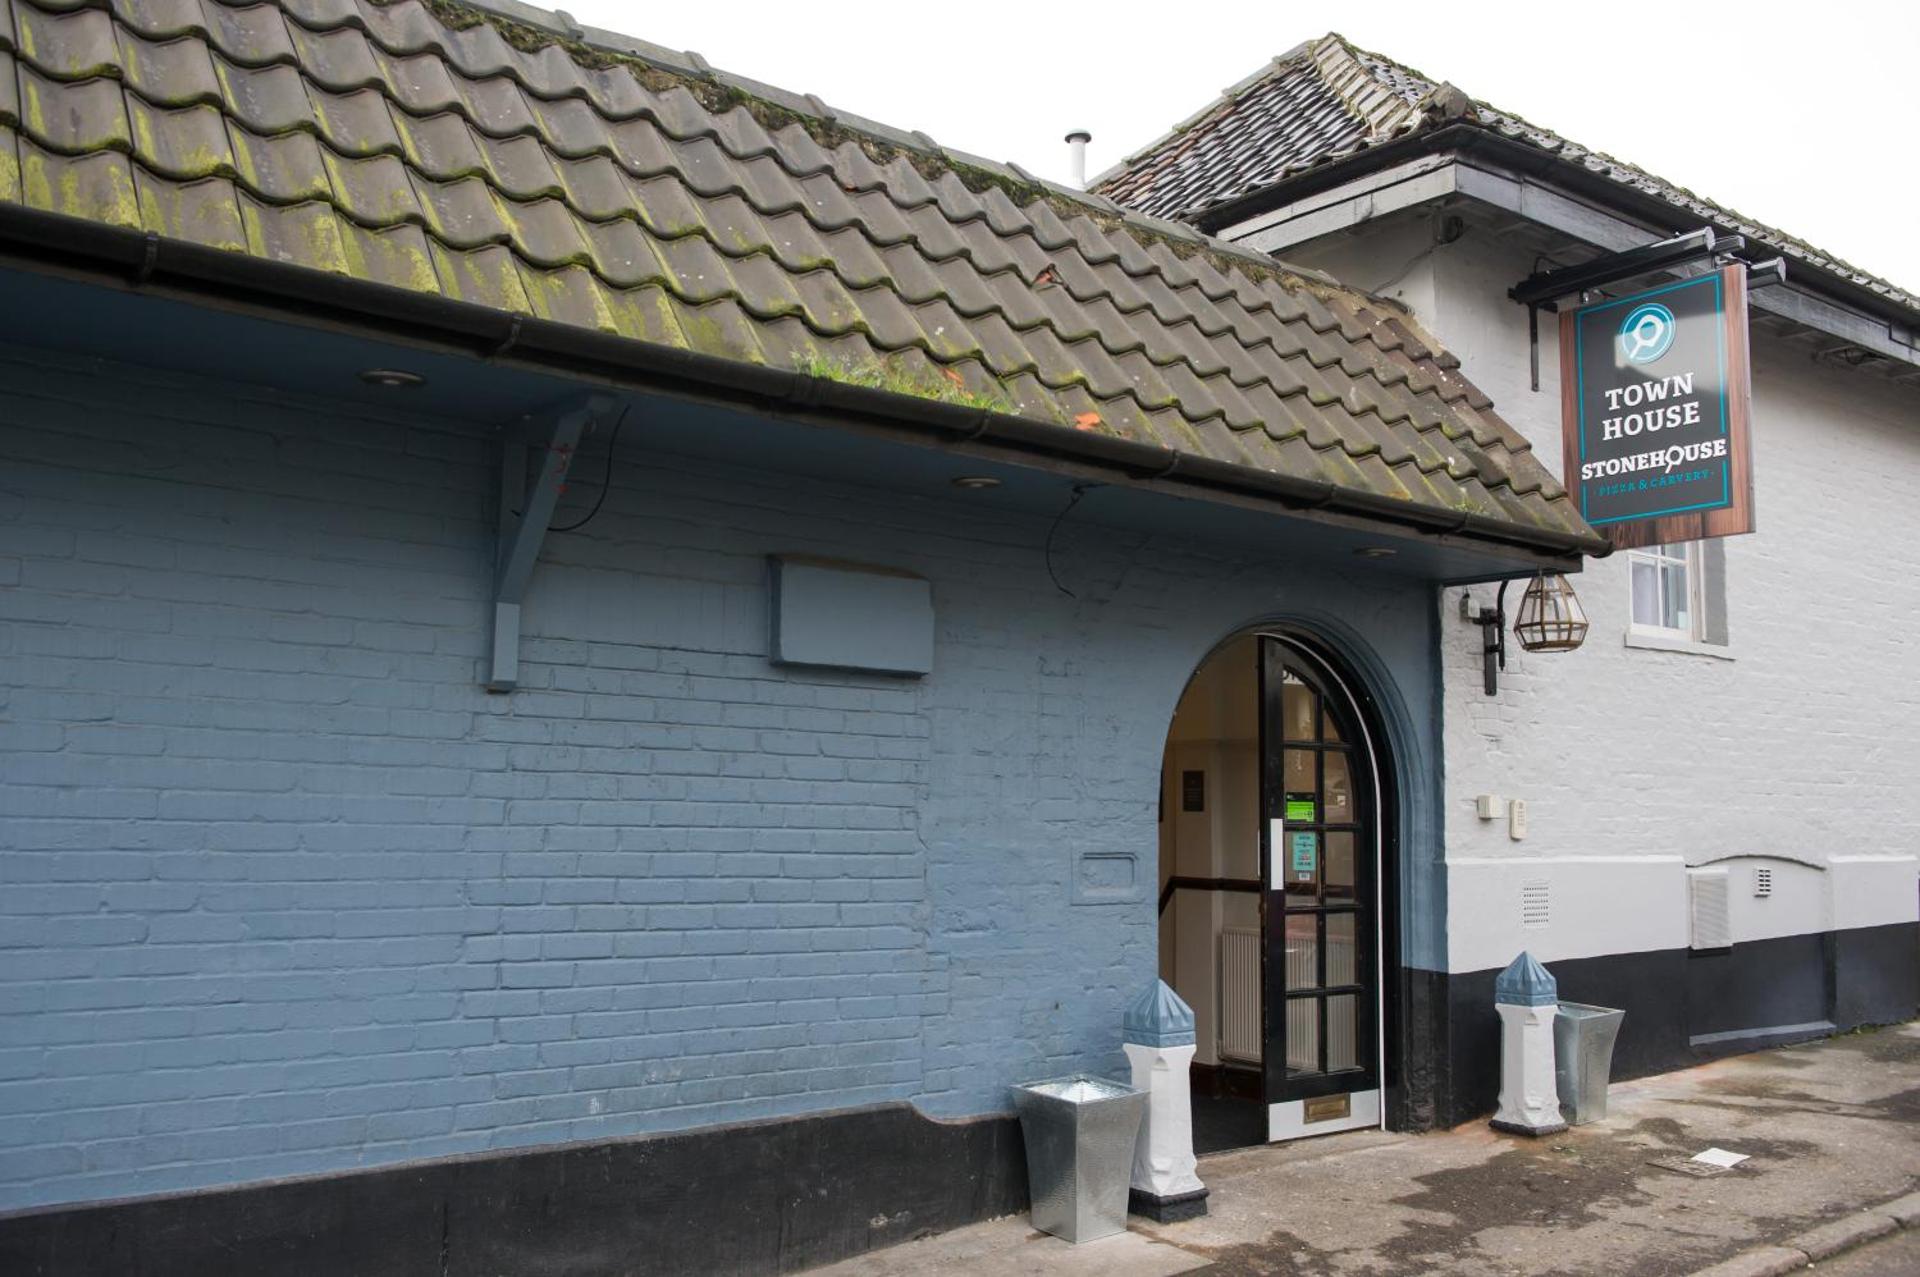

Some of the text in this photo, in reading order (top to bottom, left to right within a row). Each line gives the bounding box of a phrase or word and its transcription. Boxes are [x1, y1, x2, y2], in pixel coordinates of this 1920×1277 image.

[1605, 373, 1693, 410] TOWN
[1602, 402, 1700, 440] HOUSE
[1581, 439, 1727, 480] STONEHOUSE
[1639, 479, 1648, 490] &
